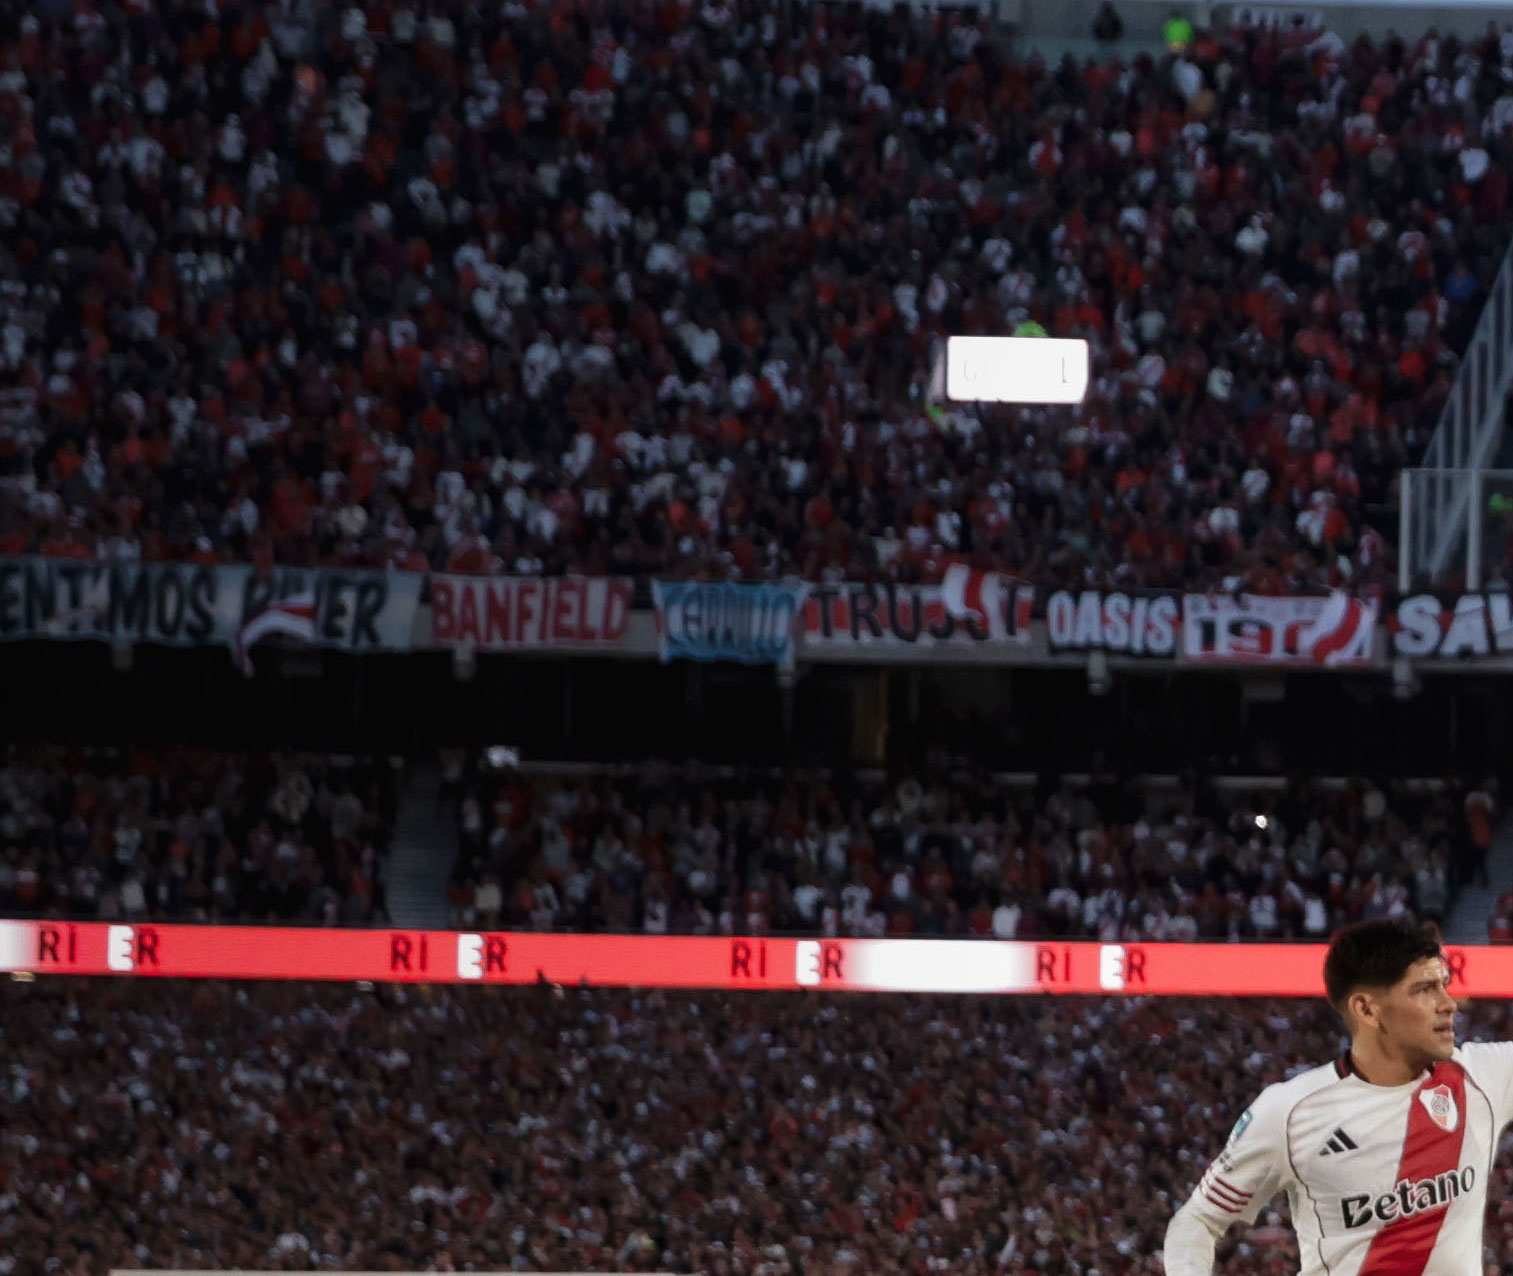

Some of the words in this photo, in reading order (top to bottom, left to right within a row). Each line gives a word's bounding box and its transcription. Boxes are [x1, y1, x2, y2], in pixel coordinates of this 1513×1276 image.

[431, 577, 634, 643] BANFIELD
[1047, 588, 1179, 656] OASIS
[1342, 1165, 1475, 1230] Betano
